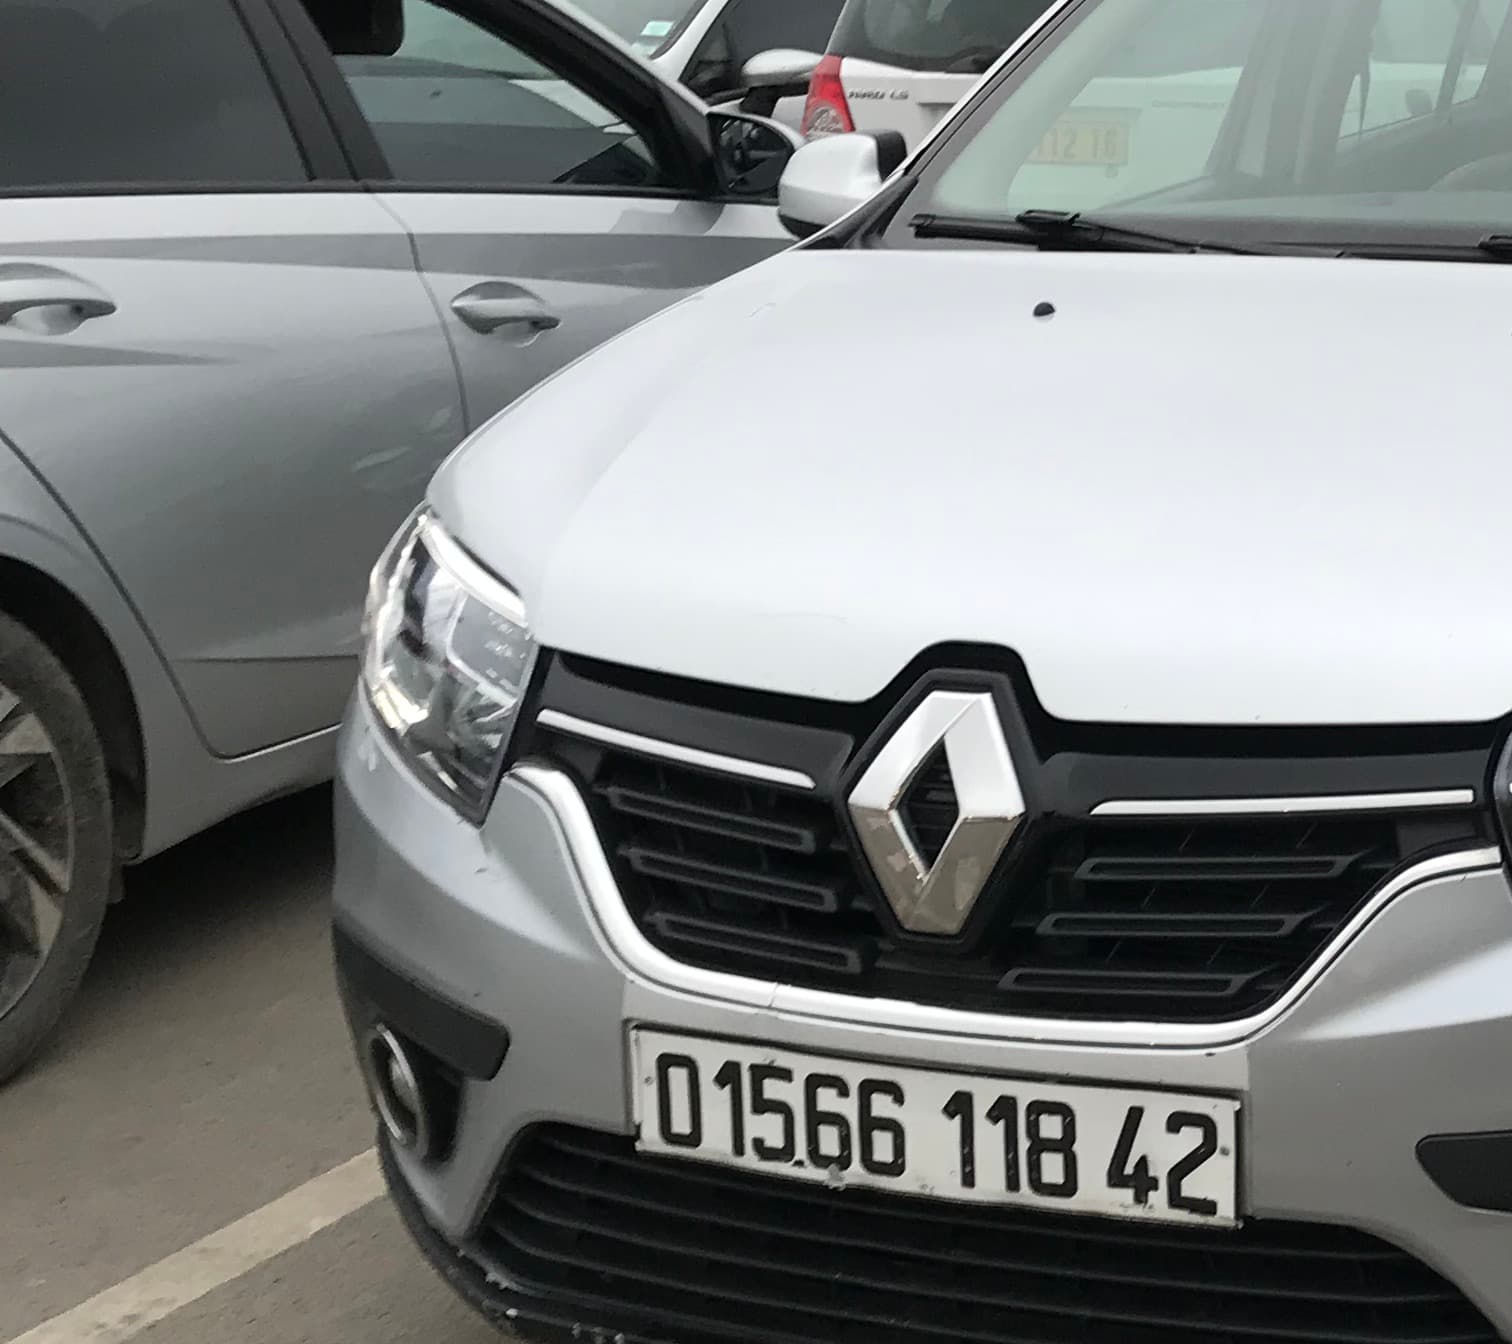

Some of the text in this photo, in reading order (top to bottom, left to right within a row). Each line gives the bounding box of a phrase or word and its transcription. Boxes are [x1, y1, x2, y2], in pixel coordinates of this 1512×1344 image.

[655, 1052, 1219, 1216] 01566 118 42
